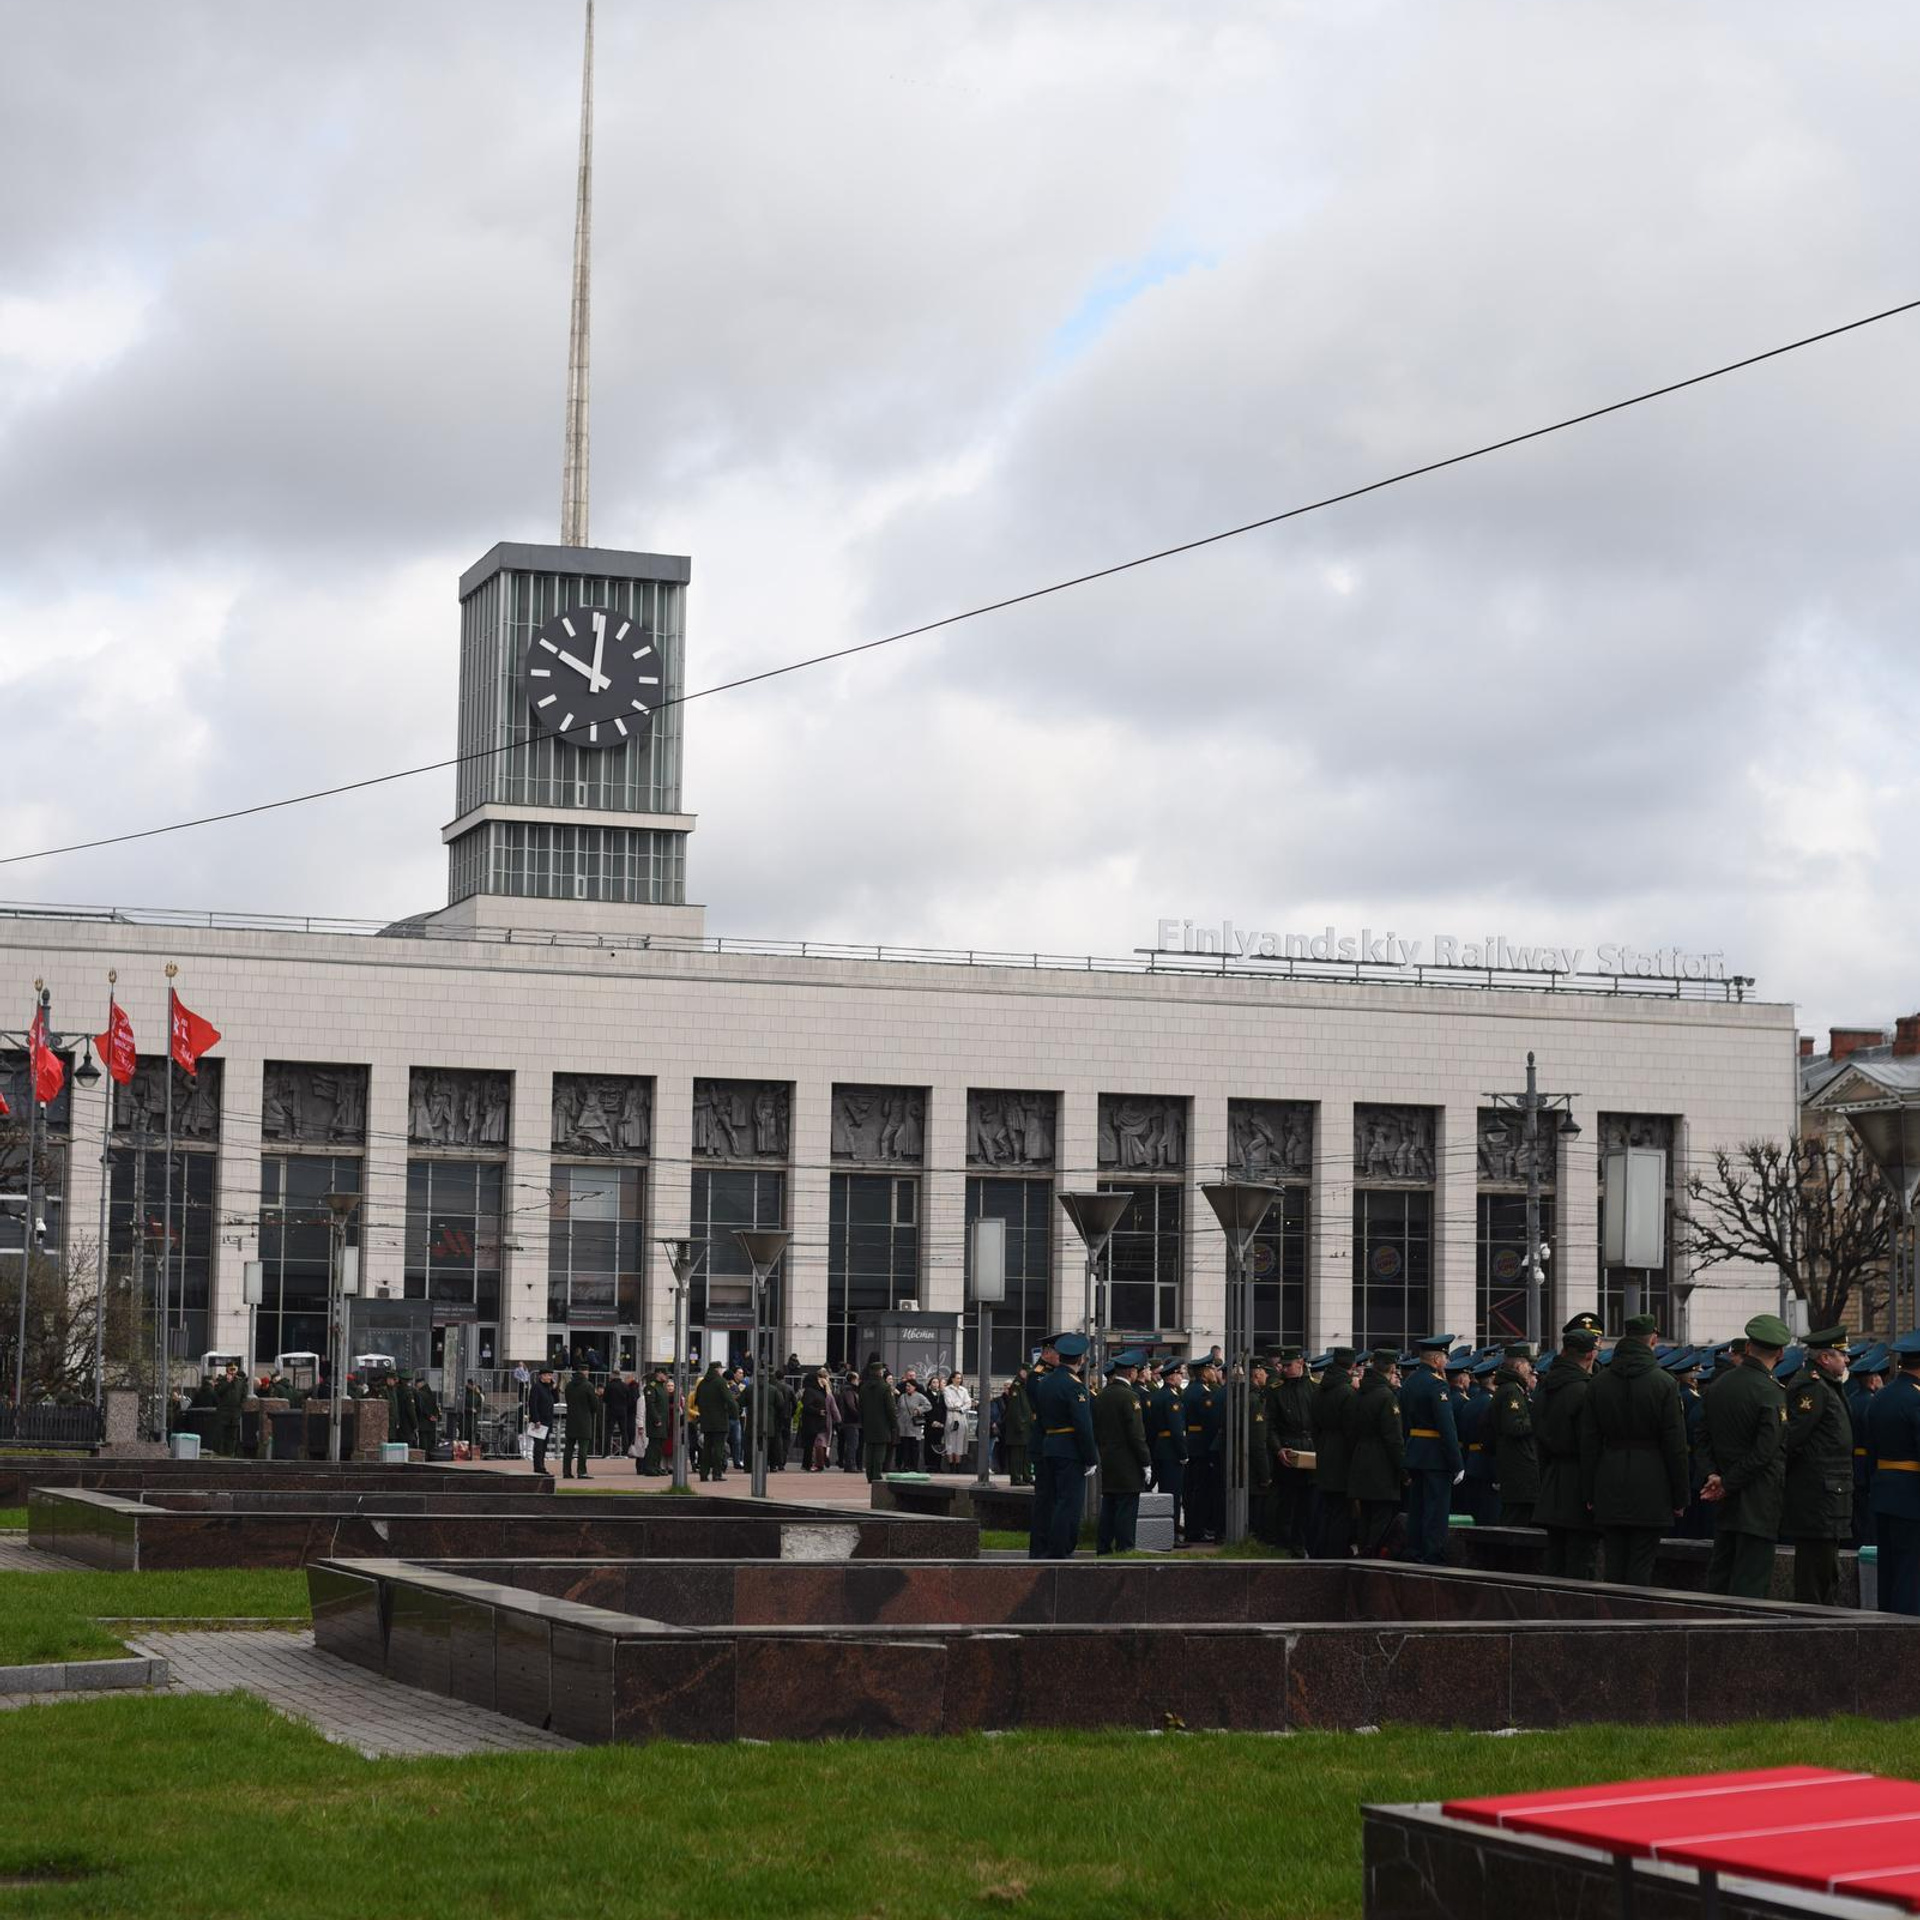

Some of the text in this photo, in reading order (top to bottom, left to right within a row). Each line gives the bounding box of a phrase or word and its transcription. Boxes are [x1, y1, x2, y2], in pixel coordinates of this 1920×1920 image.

[1157, 918, 1725, 980] Finlyandskiy Railway Station
